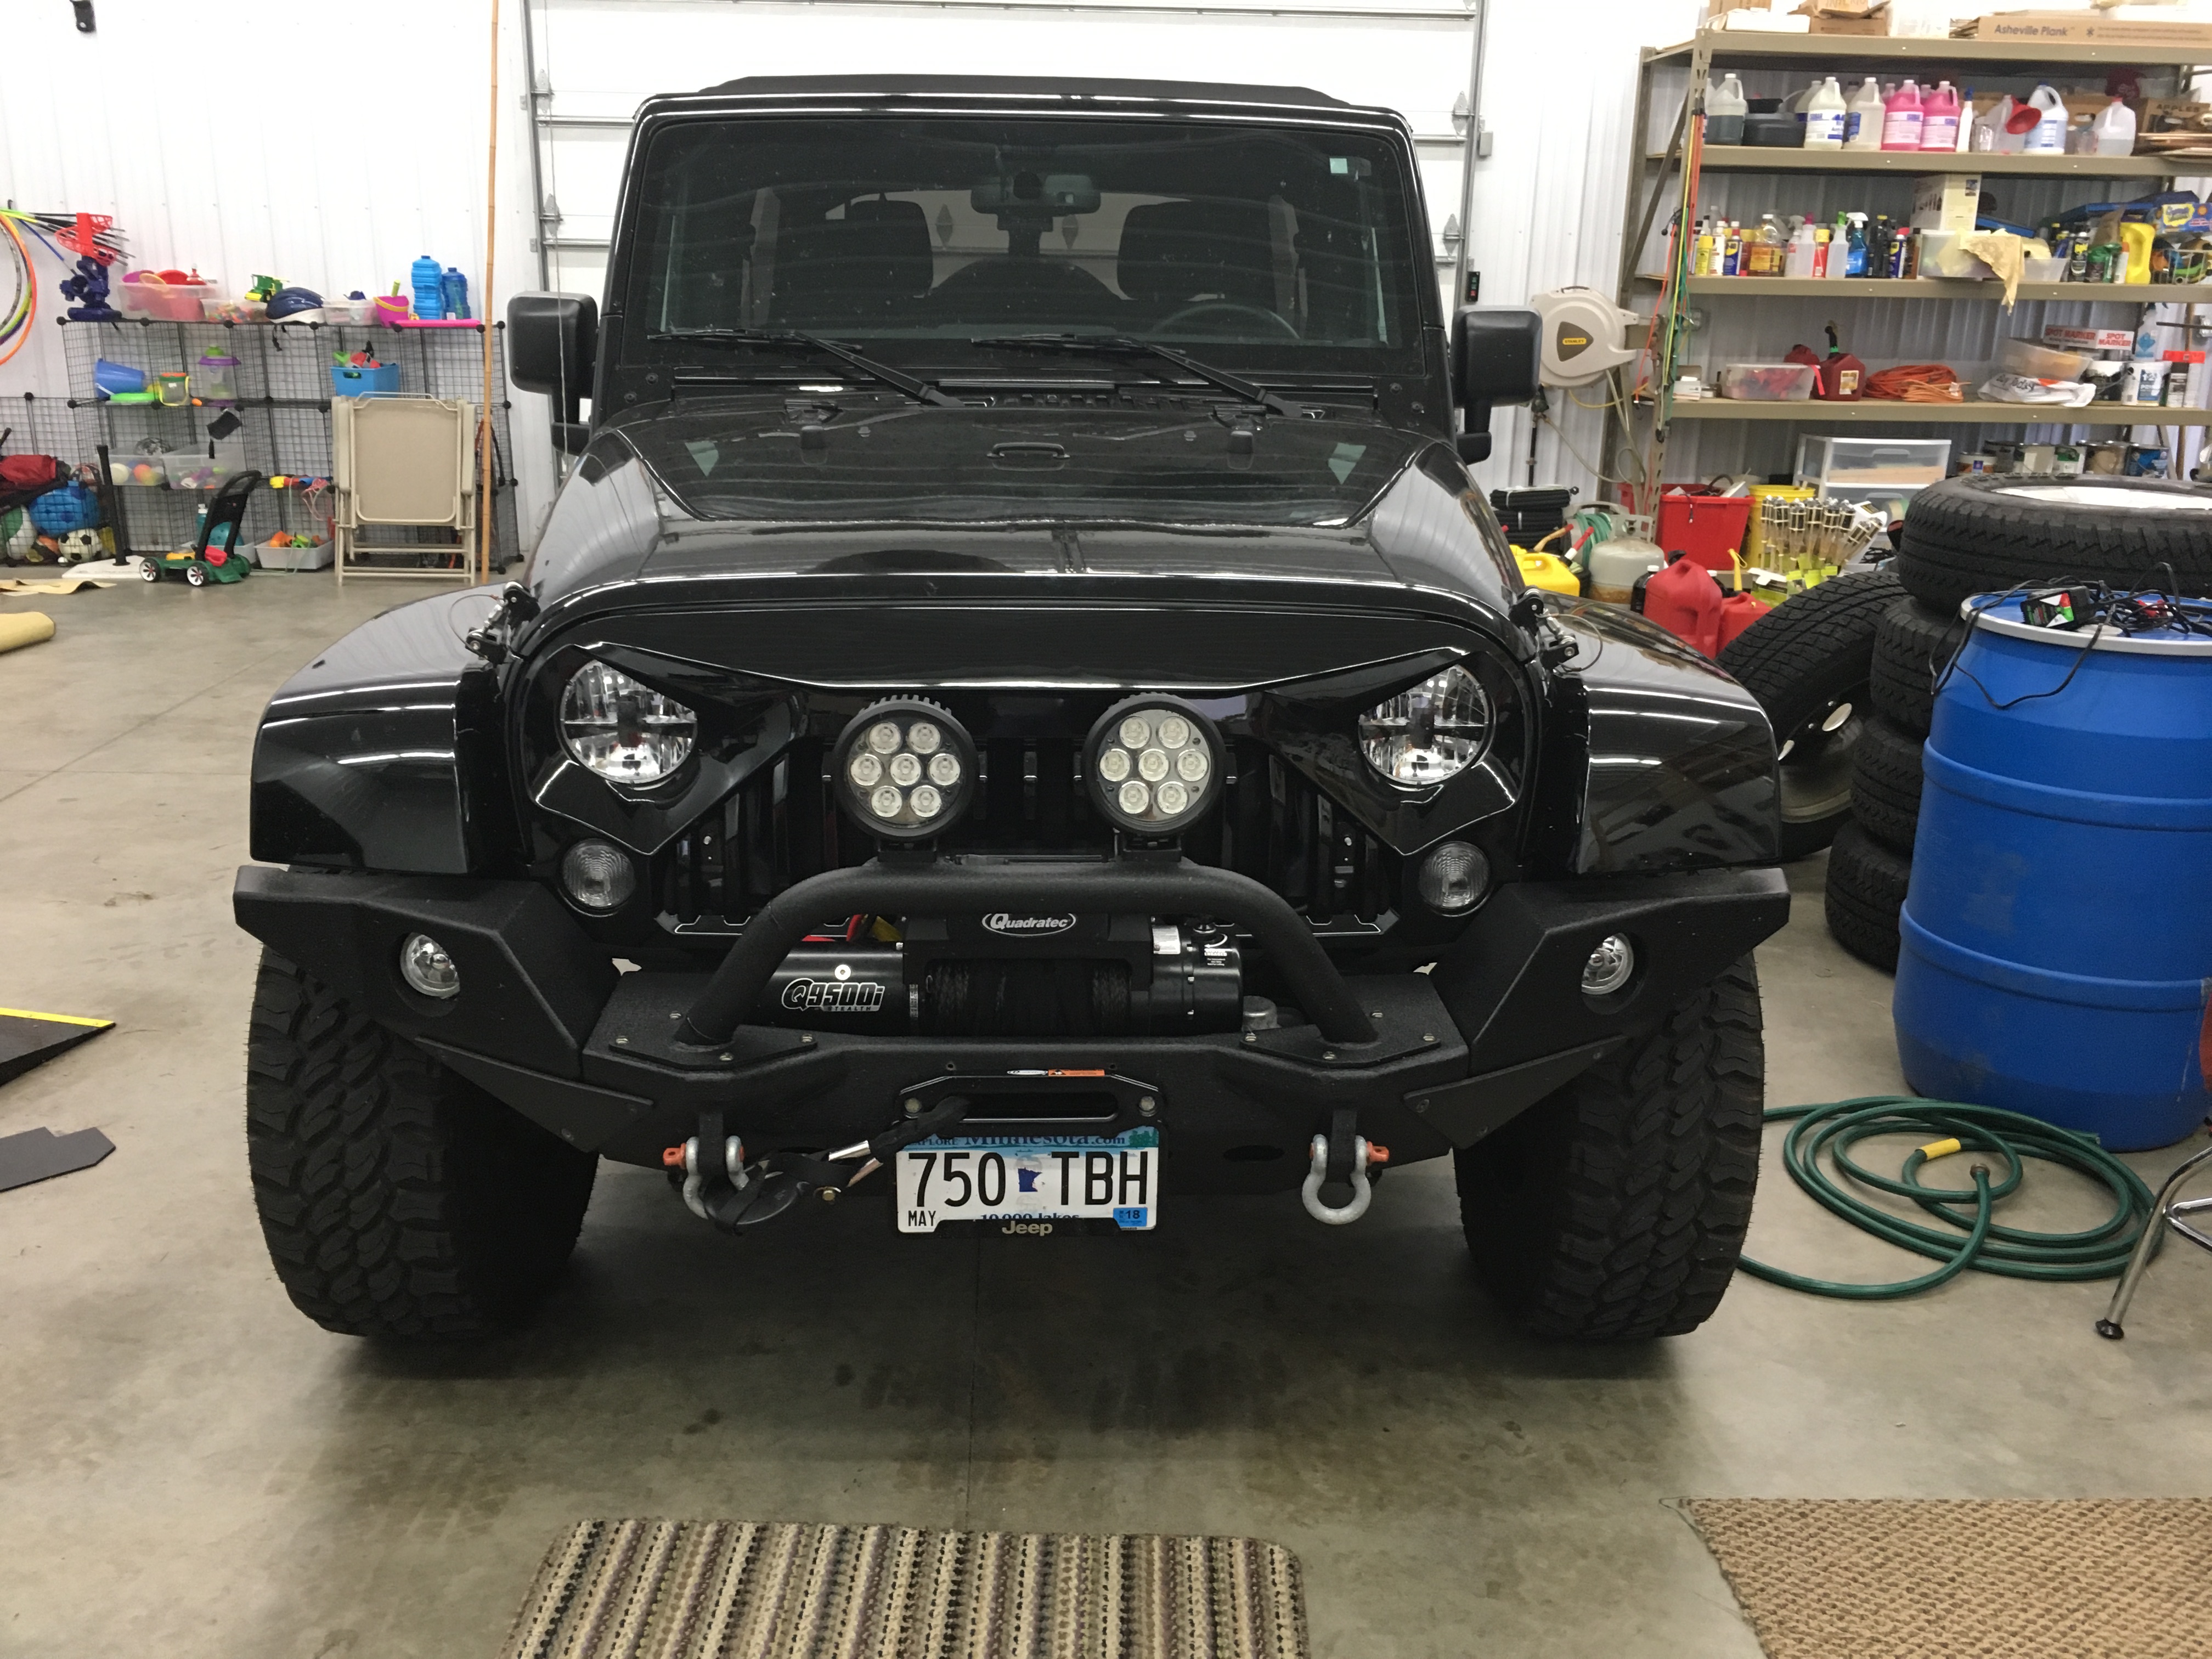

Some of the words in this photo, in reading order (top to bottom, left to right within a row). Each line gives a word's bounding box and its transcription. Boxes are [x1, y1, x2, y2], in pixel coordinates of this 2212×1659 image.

[1994, 24, 2038, 35] Asheville
[2040, 26, 2068, 36] Plank
[2156, 104, 2199, 112] APPLES
[2045, 328, 2063, 337] SPOT
[2064, 330, 2096, 340] MARKER
[2098, 338, 2131, 347] MARKER
[990, 913, 1068, 929] Quadratec
[781, 978, 885, 1012] Q9500i
[909, 1152, 1006, 1207] 750
[1051, 1151, 1148, 1206] TBH
[908, 1210, 936, 1226] MAY
[1125, 1210, 1140, 1219] 18
[1002, 1221, 1053, 1236] Jeep
